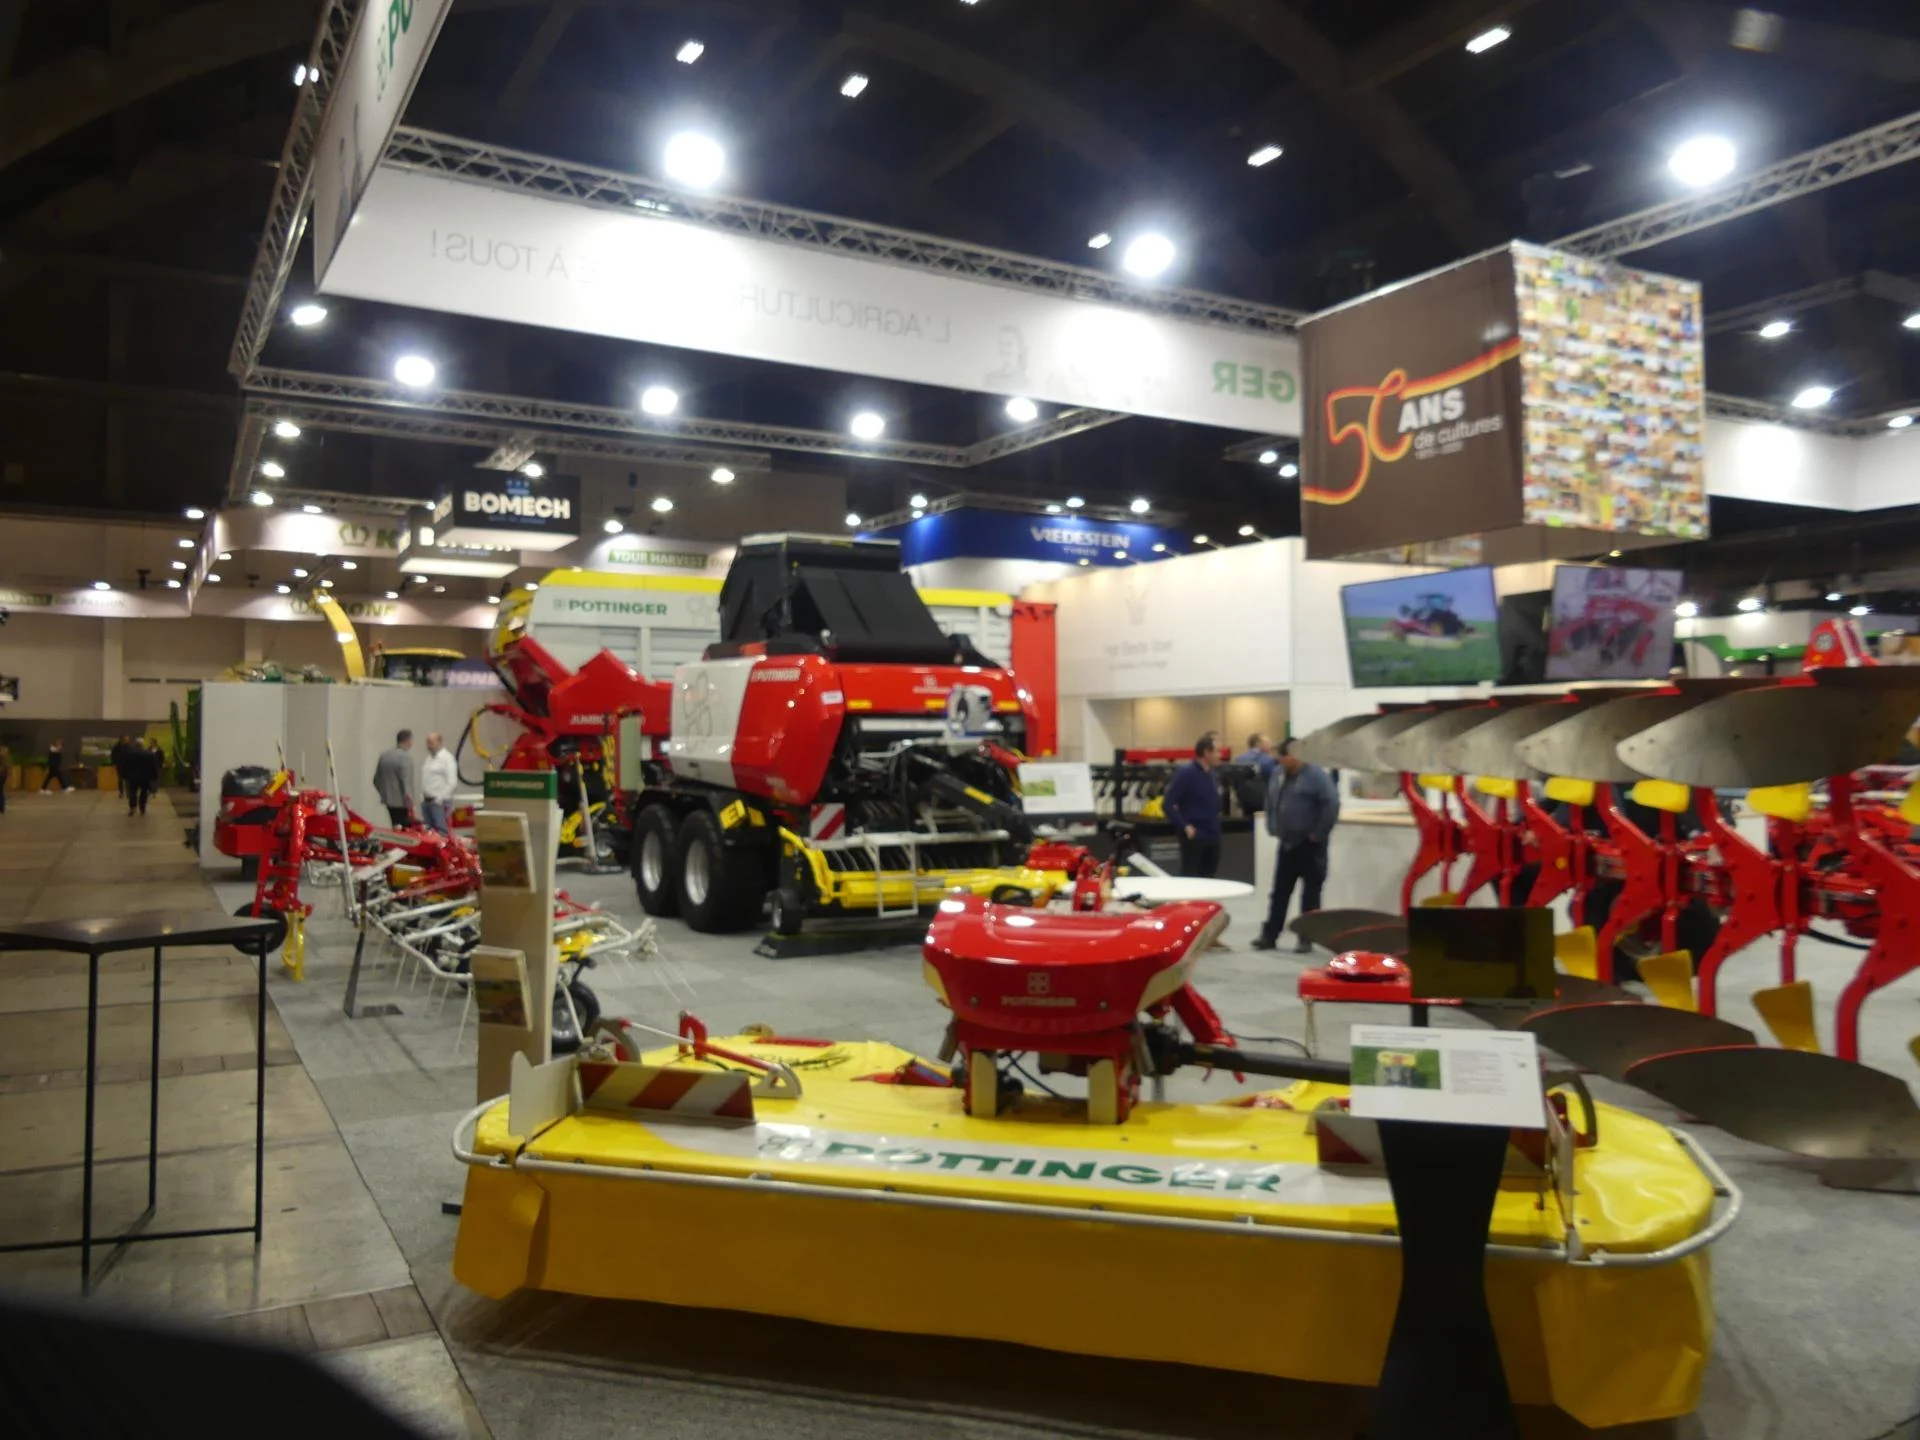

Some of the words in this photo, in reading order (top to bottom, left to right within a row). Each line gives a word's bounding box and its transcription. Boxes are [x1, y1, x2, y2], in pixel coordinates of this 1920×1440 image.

[1398, 388, 1465, 433] ANS
[1414, 430, 1445, 450] de
[1437, 414, 1504, 443] cultures
[464, 491, 571, 519] BOMECH
[614, 551, 648, 564] YOUR
[651, 553, 707, 569] HARVEST
